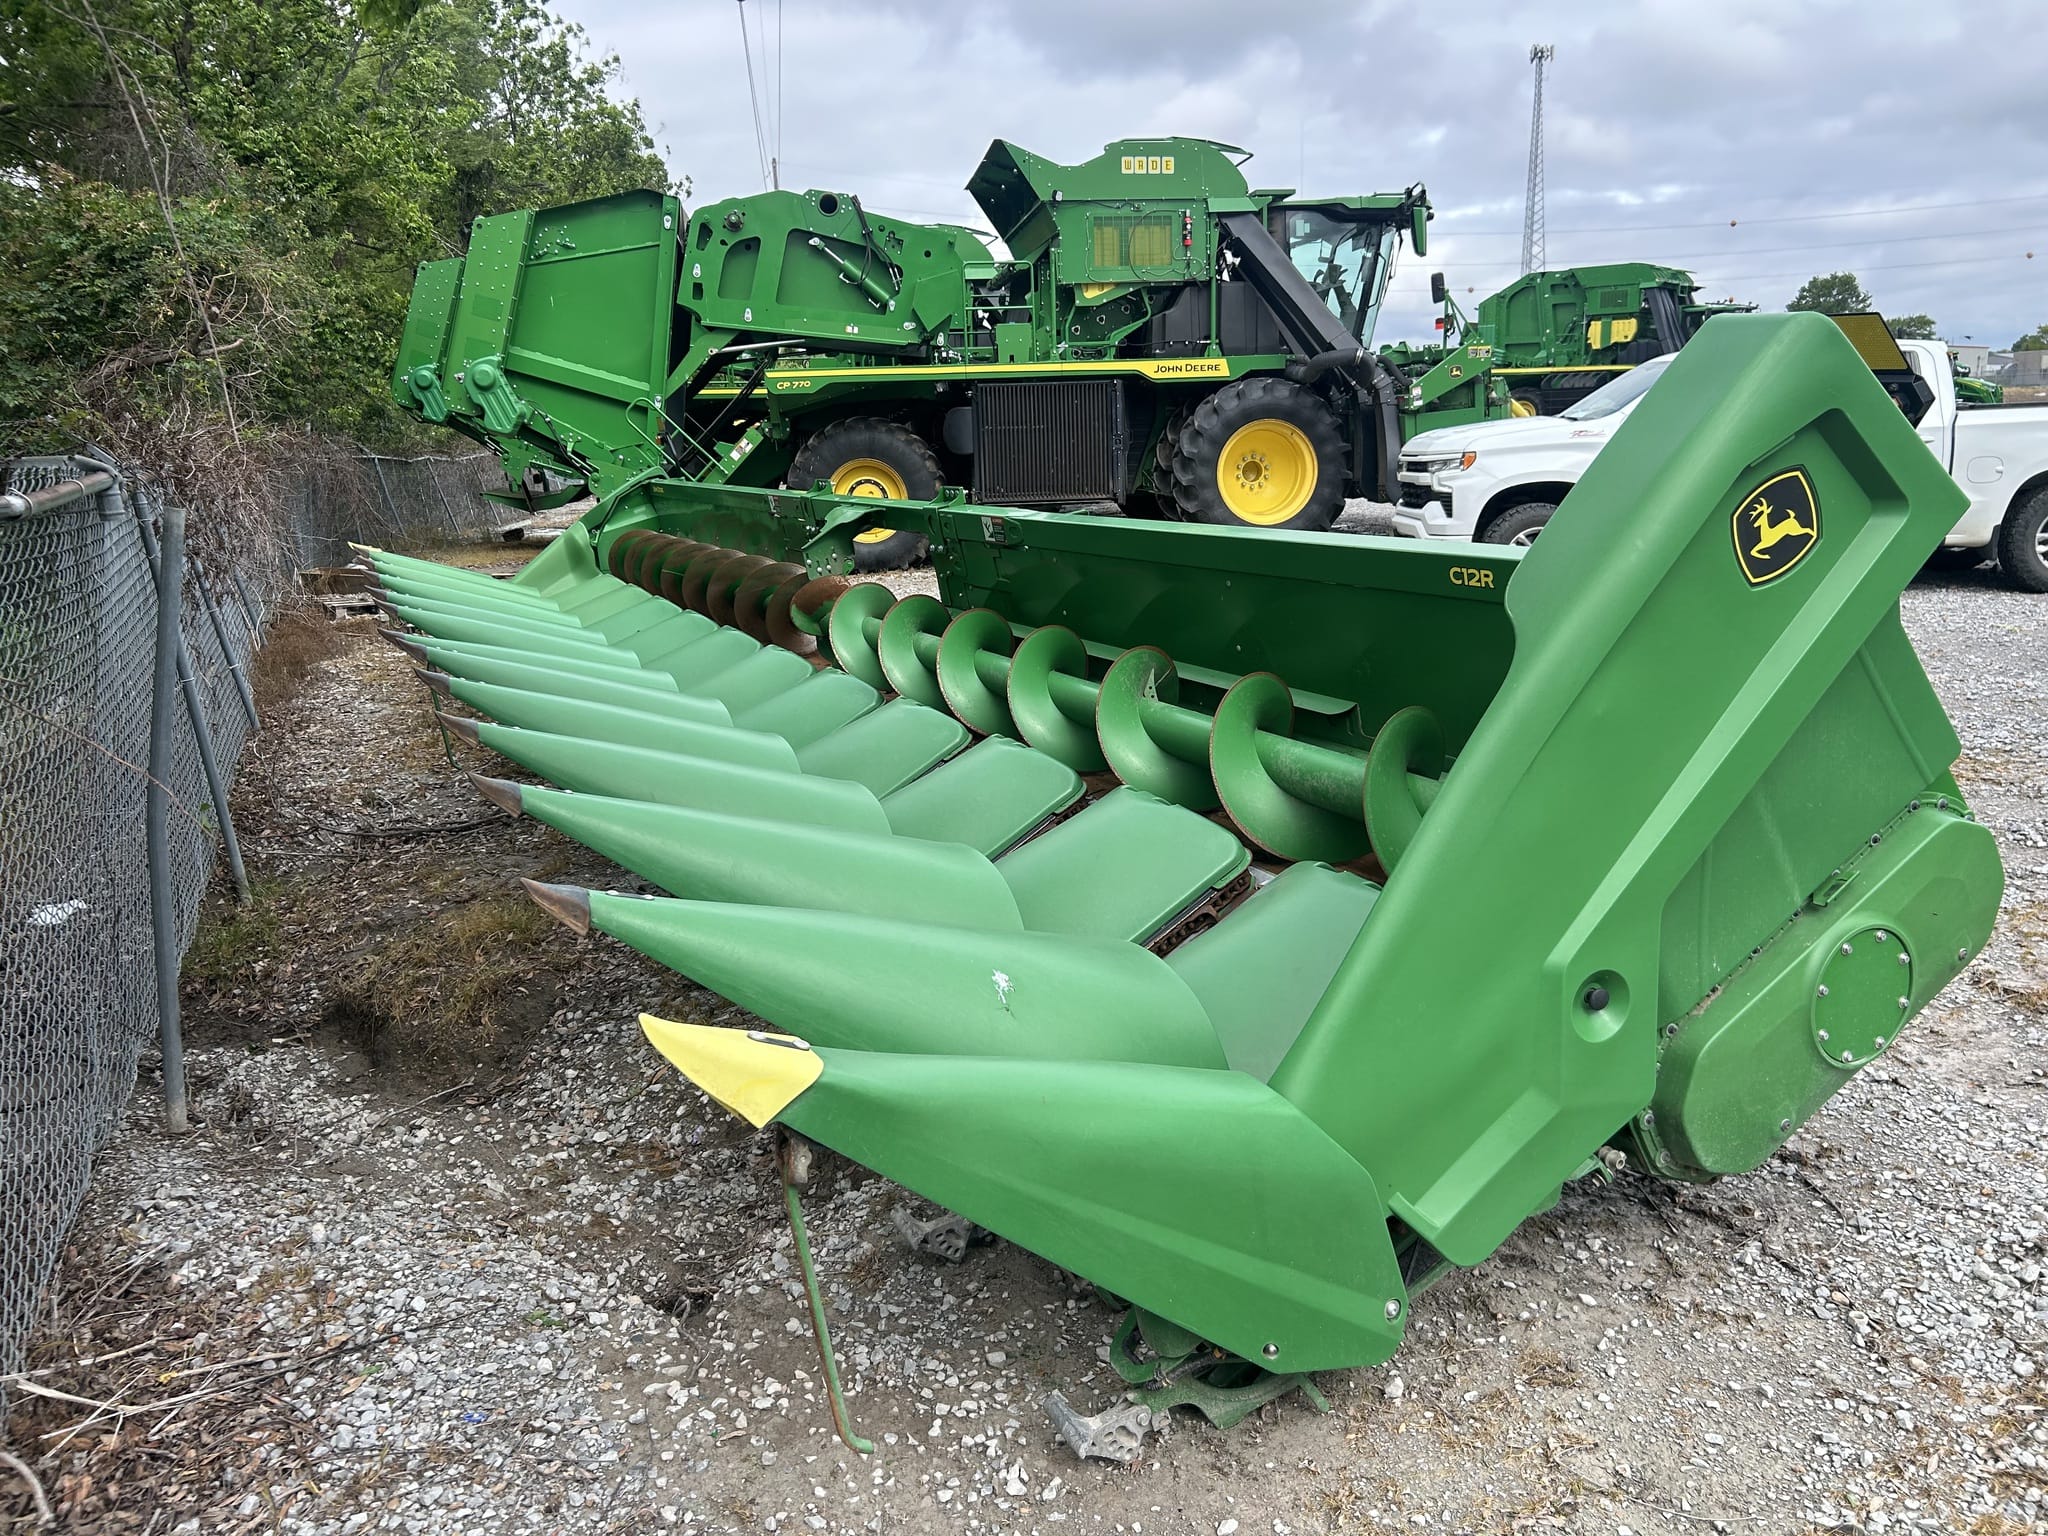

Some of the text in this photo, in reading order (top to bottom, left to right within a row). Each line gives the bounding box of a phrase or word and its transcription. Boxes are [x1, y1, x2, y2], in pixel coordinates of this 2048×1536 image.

[1124, 159, 1172, 171] WADE
[776, 380, 811, 390] CP 770
[1449, 566, 1495, 588] C12R
